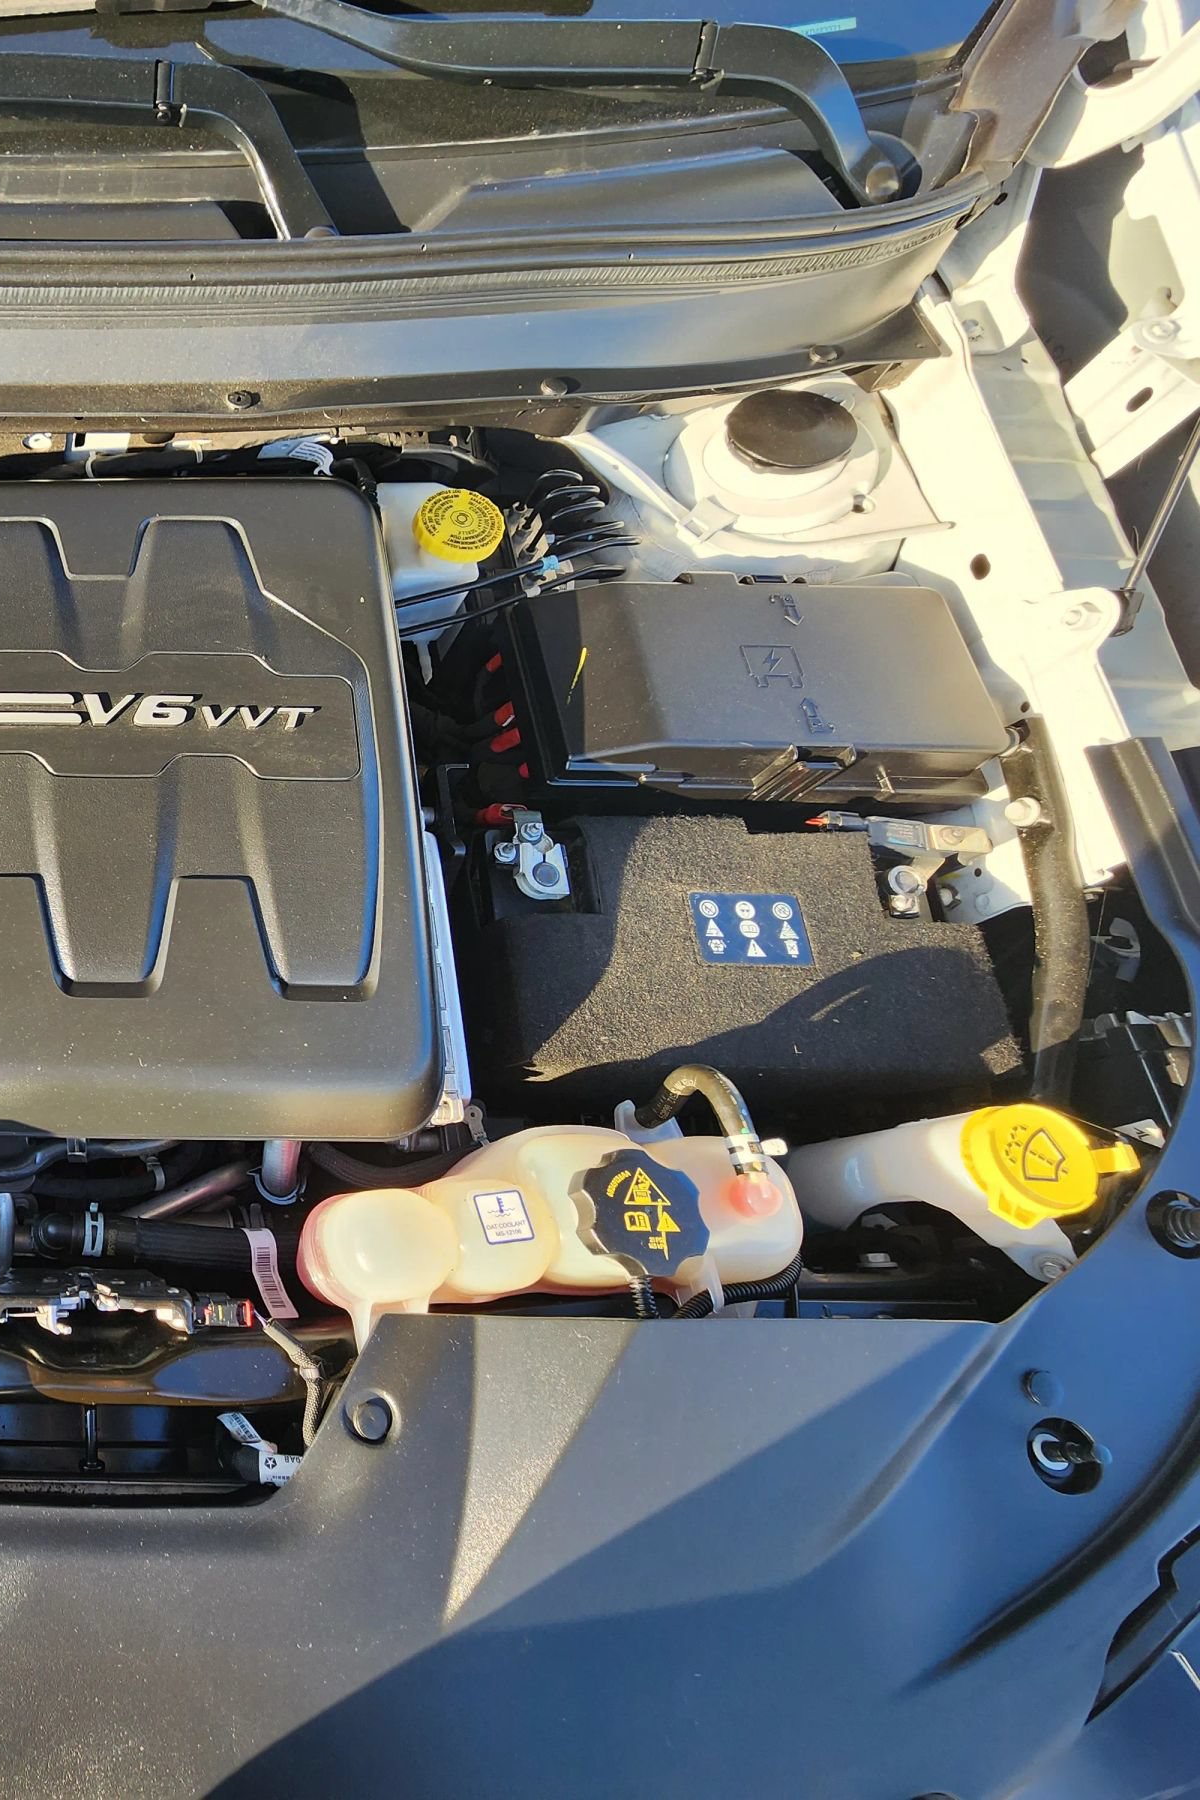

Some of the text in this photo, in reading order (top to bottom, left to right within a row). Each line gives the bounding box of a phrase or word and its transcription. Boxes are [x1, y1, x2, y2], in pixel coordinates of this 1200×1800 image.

[83, 692, 320, 731] V6 VVT
[499, 1220, 526, 1229] COOLANT
